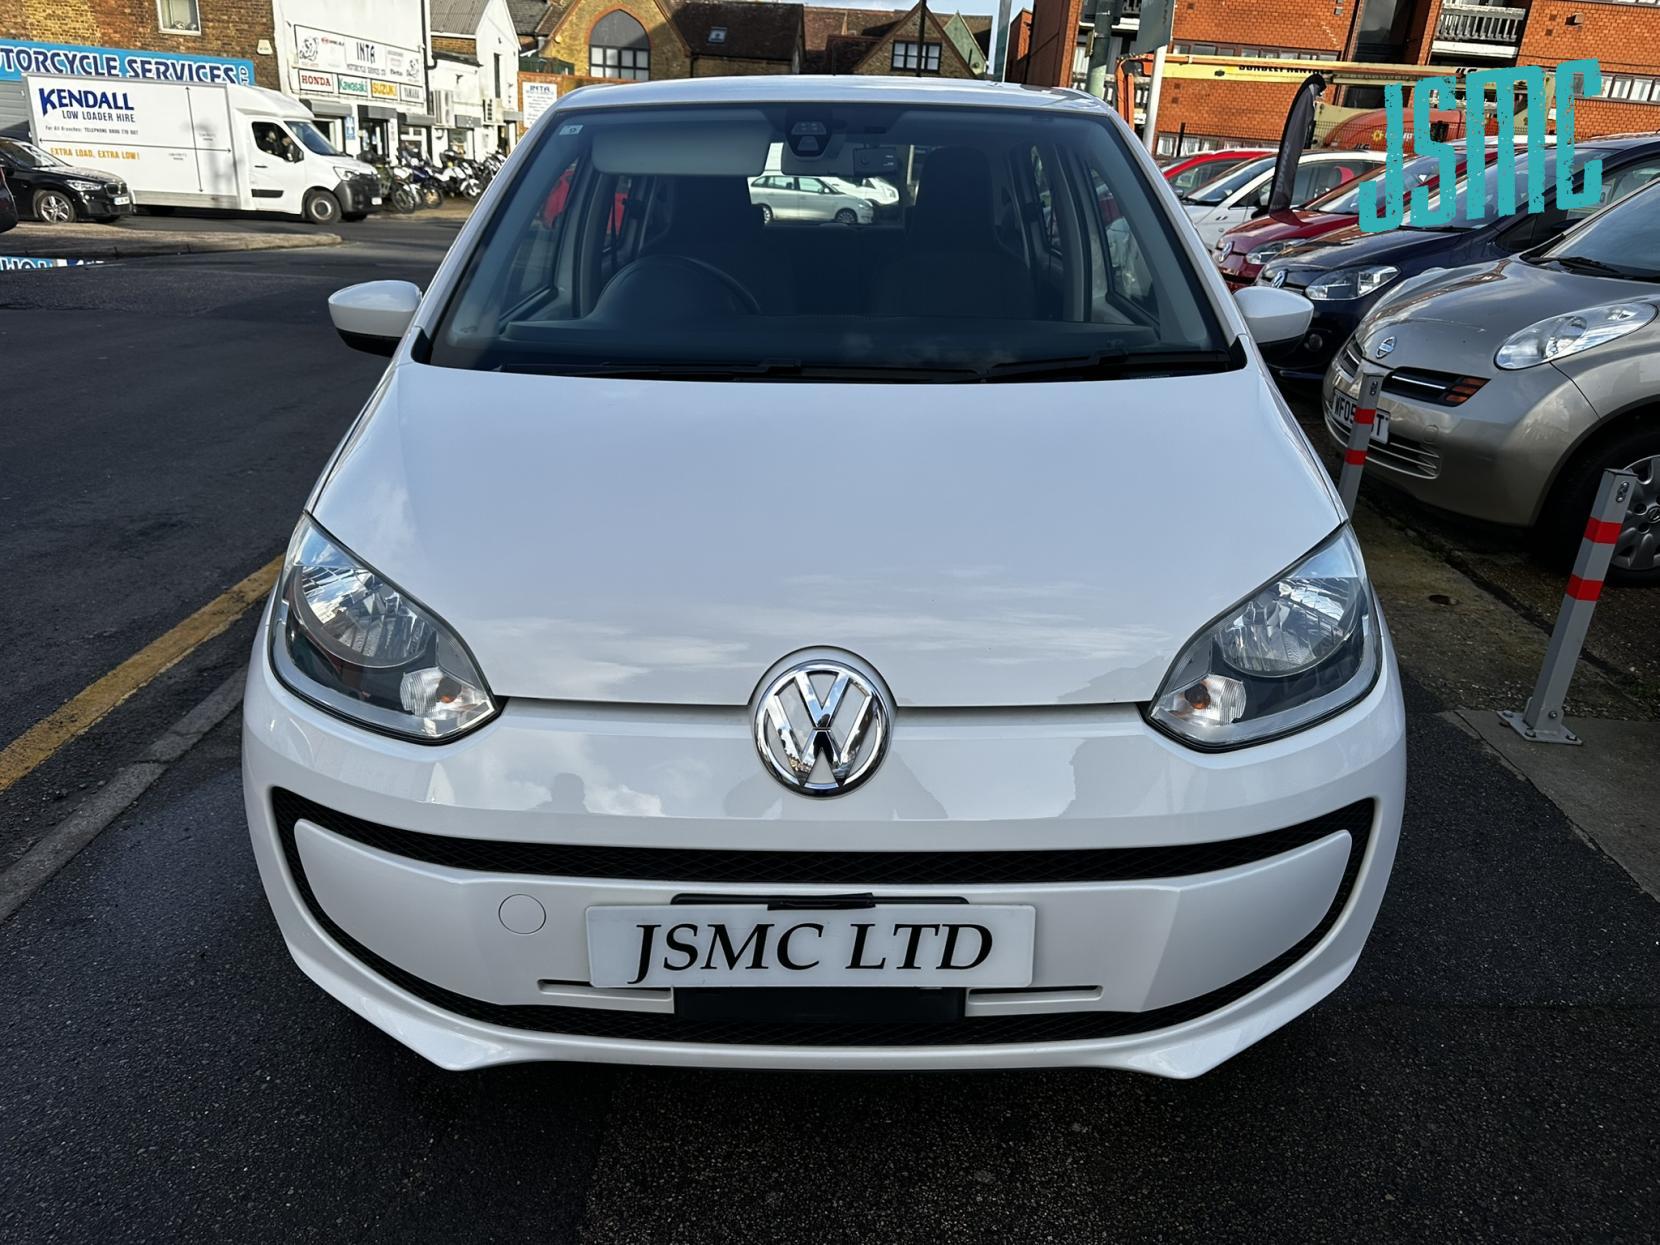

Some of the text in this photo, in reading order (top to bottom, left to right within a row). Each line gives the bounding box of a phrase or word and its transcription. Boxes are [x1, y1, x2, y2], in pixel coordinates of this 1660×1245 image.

[356, 41, 376, 64] INTA
[125, 57, 236, 85] SERVICES
[240, 66, 249, 87] TD
[301, 74, 331, 87] HONDA
[339, 78, 368, 92] Kawasaki
[372, 82, 397, 96] SUZUKI
[39, 87, 134, 117] KENDALL
[62, 110, 136, 123] LOW LOADER HIRE
[50, 147, 73, 157] EXTRA
[98, 149, 120, 159] EXTRA
[627, 923, 994, 985] JSMC LTD
